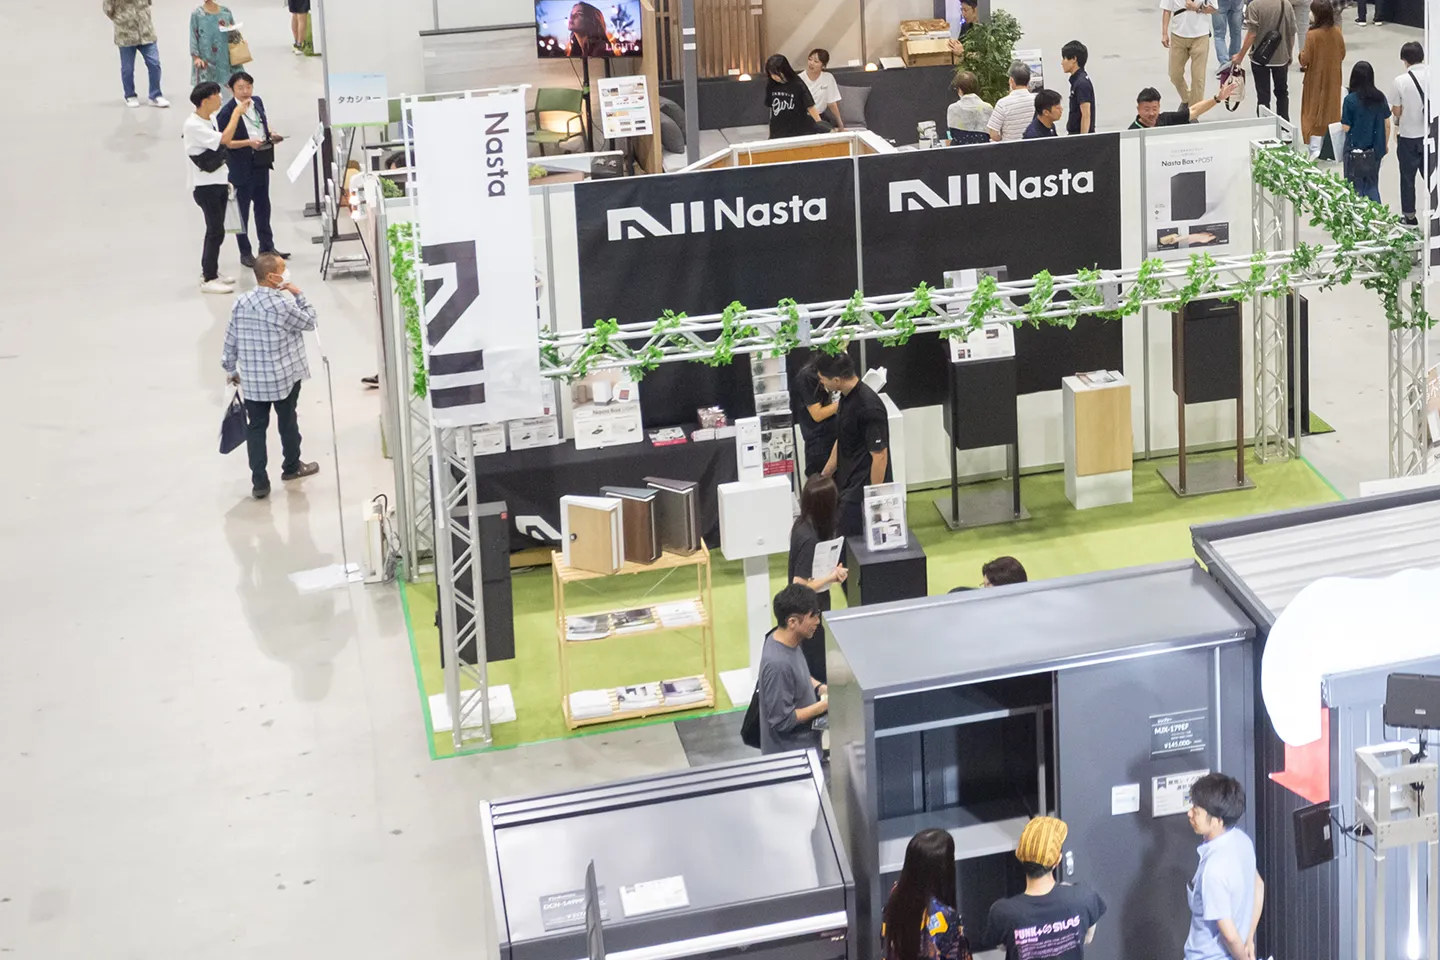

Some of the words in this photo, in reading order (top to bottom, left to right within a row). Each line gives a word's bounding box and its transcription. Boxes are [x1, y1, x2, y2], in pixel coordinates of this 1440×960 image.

[337, 96, 382, 104] タカショー
[483, 111, 510, 198] Nasta
[1161, 158, 1181, 167] Nasta
[1182, 157, 1194, 165] Box
[990, 168, 1095, 203] Nasta
[714, 194, 828, 231] Nasta
